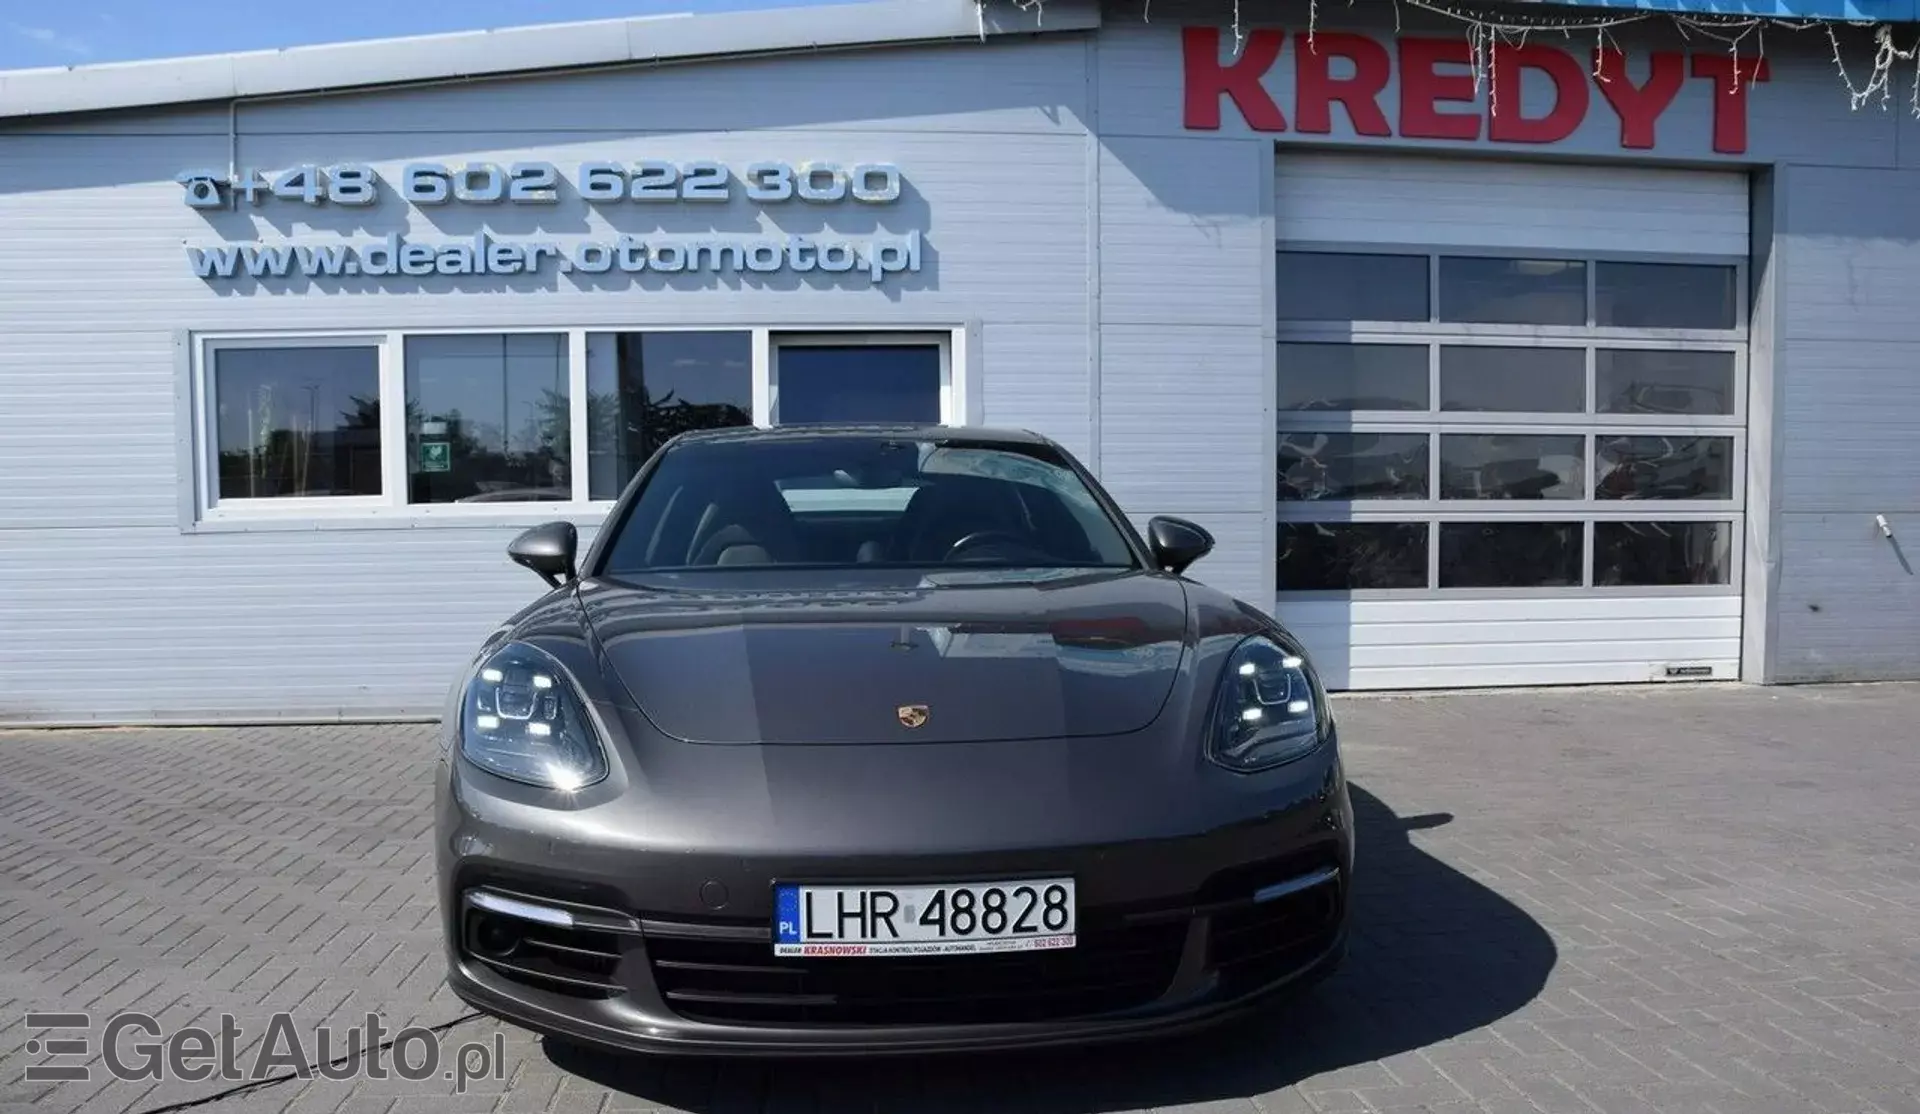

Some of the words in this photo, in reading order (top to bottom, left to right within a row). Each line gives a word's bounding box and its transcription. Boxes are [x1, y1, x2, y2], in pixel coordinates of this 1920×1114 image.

[1182, 25, 1770, 154] KREDYT
[230, 163, 377, 207] +48
[402, 161, 558, 204] 602
[578, 161, 730, 204] 622
[746, 160, 902, 204] 300
[188, 228, 922, 283] www.dealer.otomoto.pl
[779, 921, 798, 935] PL
[805, 890, 900, 939] LHR
[918, 884, 1070, 937] 48828
[803, 944, 867, 955] KRASNOWSKI
